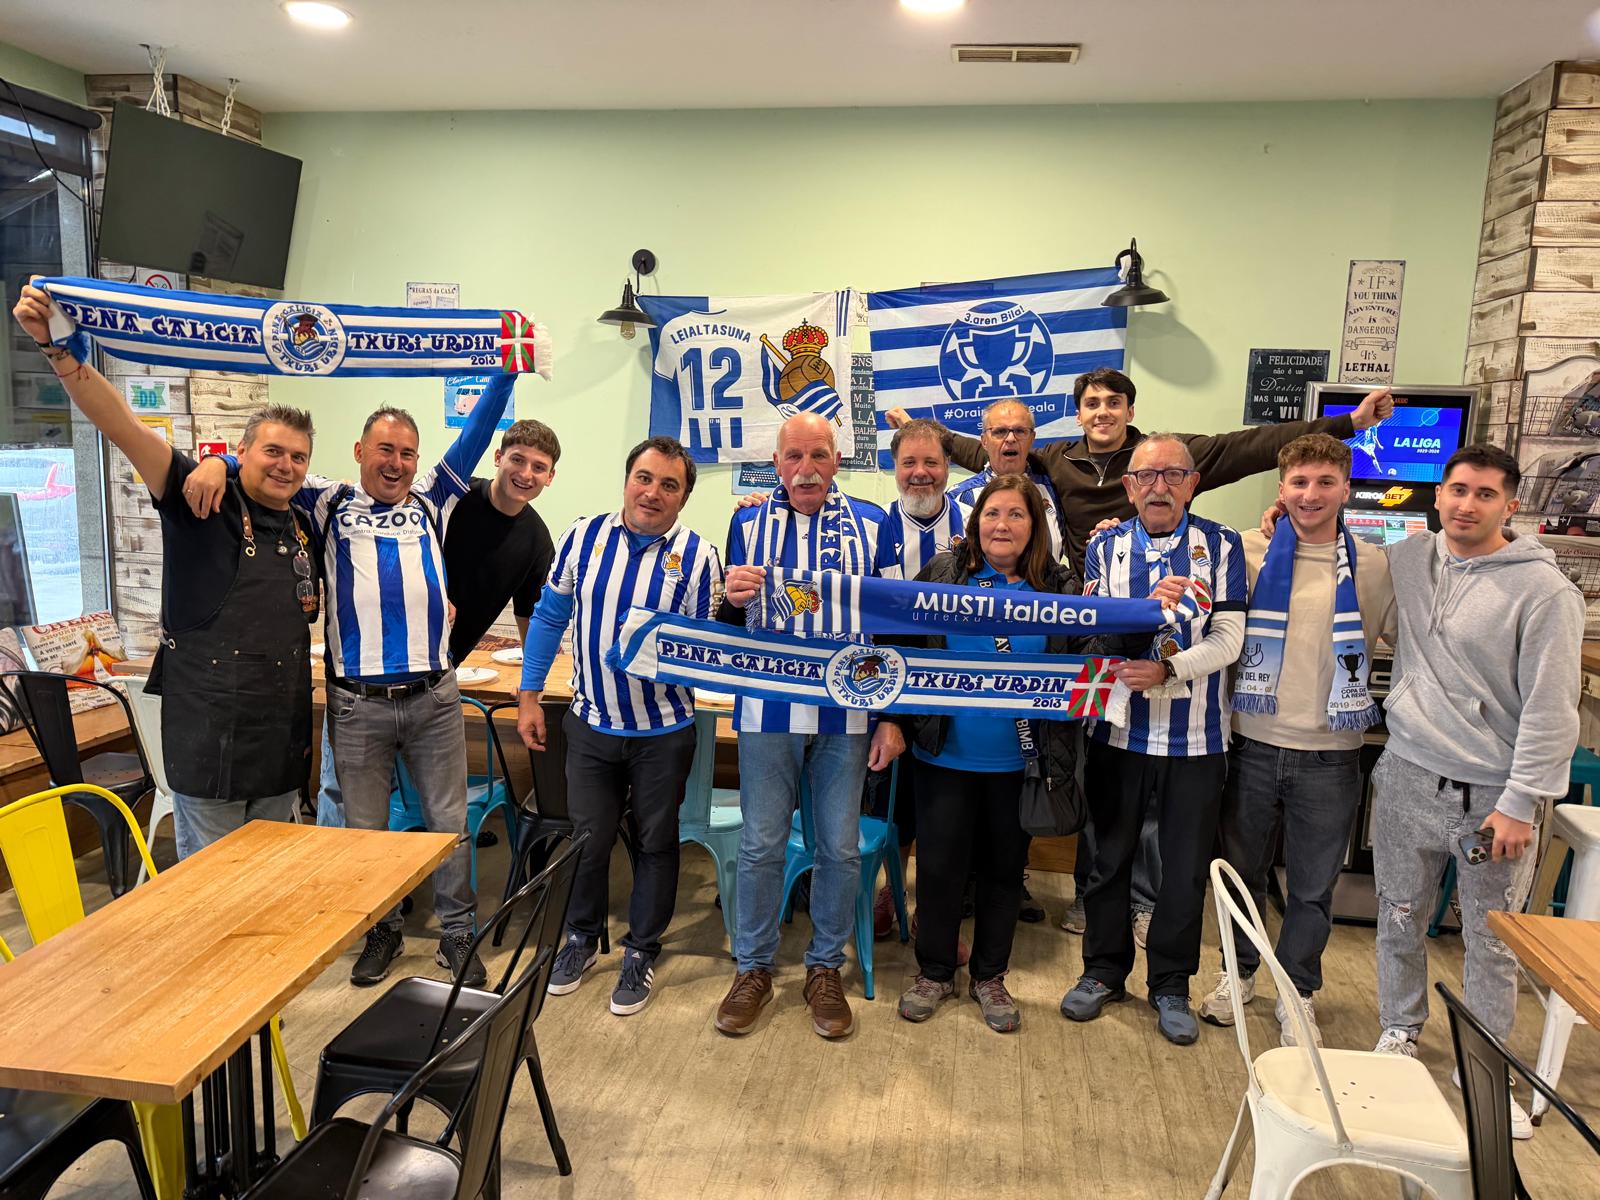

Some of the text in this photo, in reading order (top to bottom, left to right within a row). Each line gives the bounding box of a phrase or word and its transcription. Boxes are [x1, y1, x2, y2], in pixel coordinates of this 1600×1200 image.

[1367, 276, 1387, 289] IF
[1354, 292, 1397, 300] YOU THINK
[964, 305, 1025, 325] 3.aren Bila!
[1348, 305, 1399, 317] ADVENTURE
[1368, 315, 1377, 323] is
[670, 324, 751, 345] LEIALTASUNA
[1347, 325, 1396, 334] DANGEROUS
[471, 355, 496, 366] 2013
[1361, 350, 1377, 360] It's
[851, 357, 873, 367] ENS
[1256, 356, 1323, 366] A FELICIDADE
[1345, 362, 1391, 373] LETHAL
[680, 347, 743, 410] 12
[854, 393, 875, 403] ME
[1262, 406, 1300, 419] de VIV
[1394, 437, 1441, 448] LA LIGA
[340, 511, 421, 528] CAZOO
[913, 592, 1097, 626] MUSTI taldea
[1245, 671, 1257, 681] DEL
[1258, 673, 1270, 682] REY
[1032, 698, 1062, 708] 2013
[1329, 701, 1350, 709] 2019
[1016, 719, 1034, 750] BIMB
